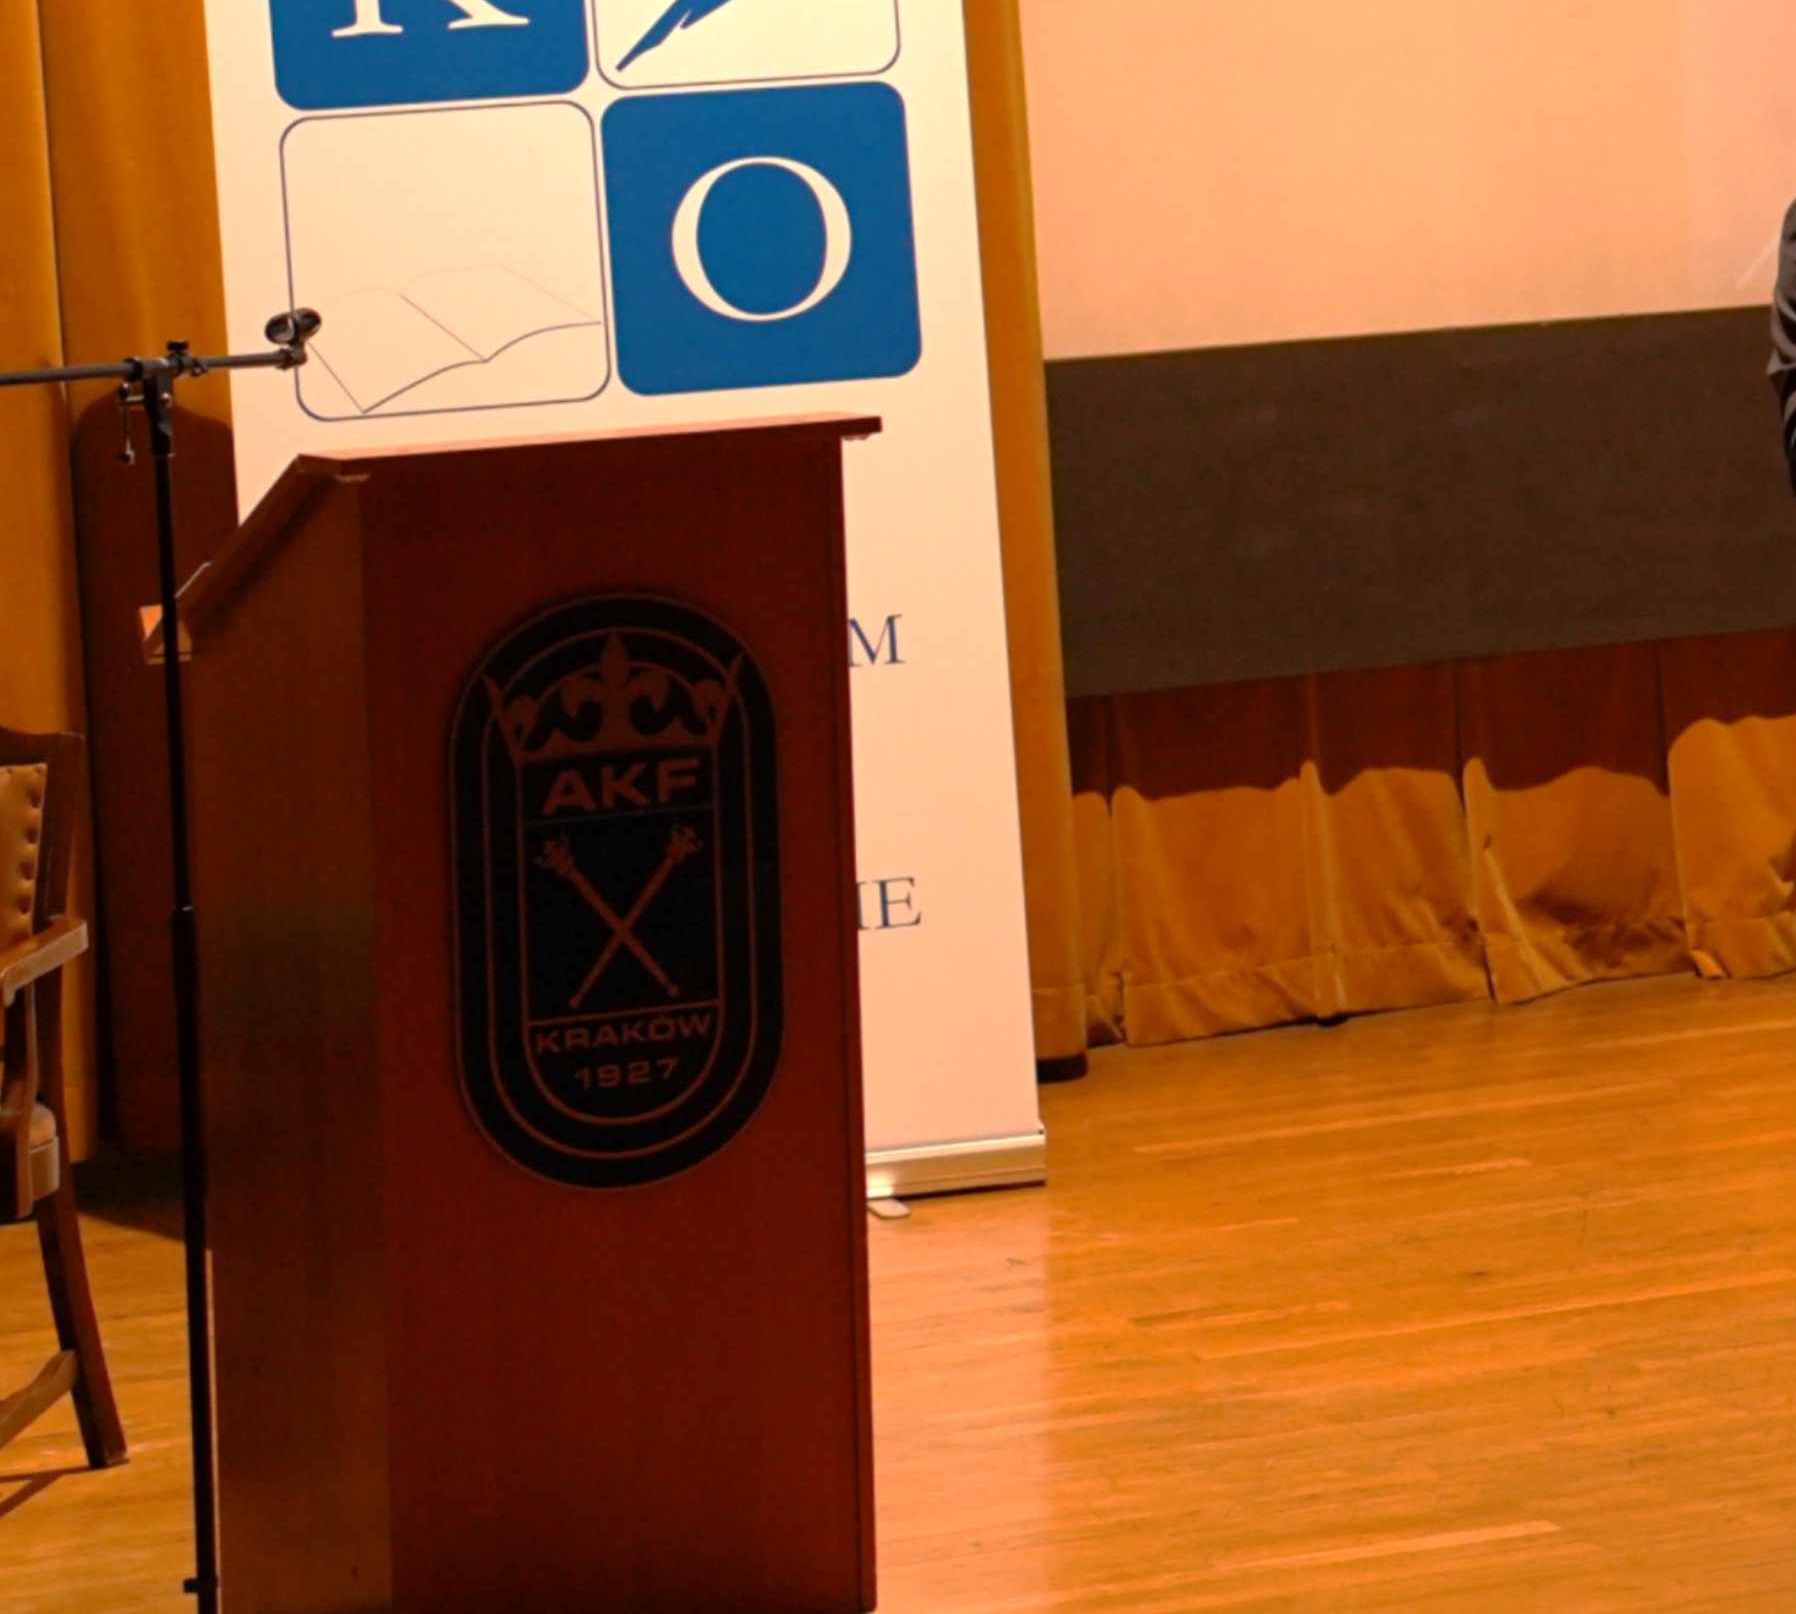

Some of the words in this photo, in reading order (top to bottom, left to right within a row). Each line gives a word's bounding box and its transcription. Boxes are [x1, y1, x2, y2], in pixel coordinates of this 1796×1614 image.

[670, 154, 853, 323] O
[542, 755, 702, 816] AKF
[535, 1010, 713, 1057] KRAKÓW
[573, 1055, 682, 1093] 1927
